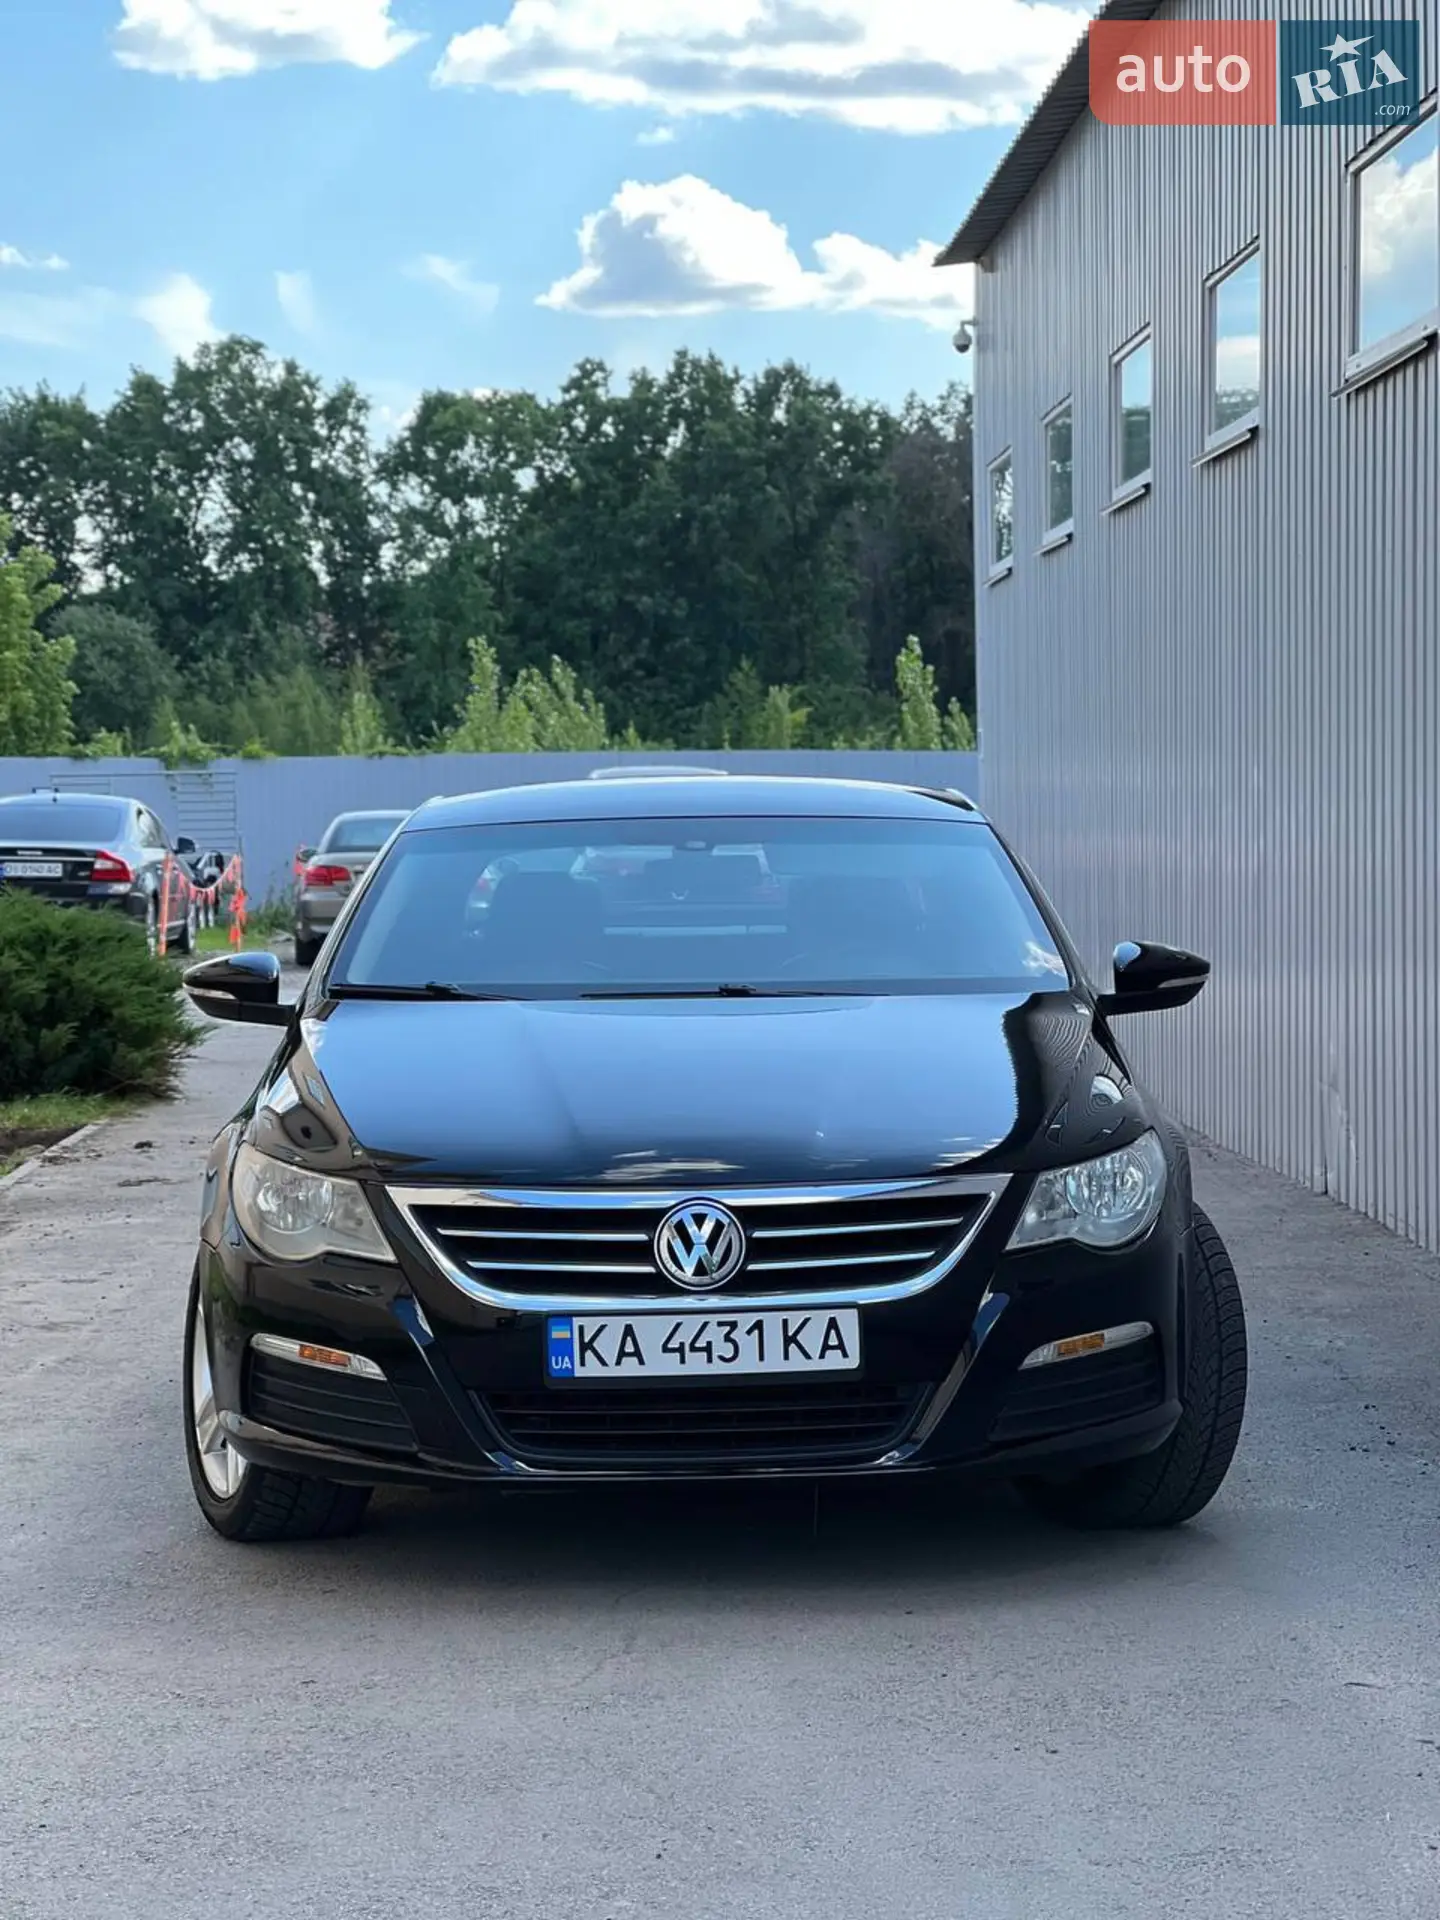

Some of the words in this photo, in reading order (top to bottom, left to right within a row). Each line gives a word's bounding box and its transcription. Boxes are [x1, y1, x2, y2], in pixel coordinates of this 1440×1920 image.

[577, 1323, 646, 1368] KA
[661, 1318, 765, 1365] 4431
[781, 1316, 850, 1361] KA
[551, 1355, 572, 1370] UA
